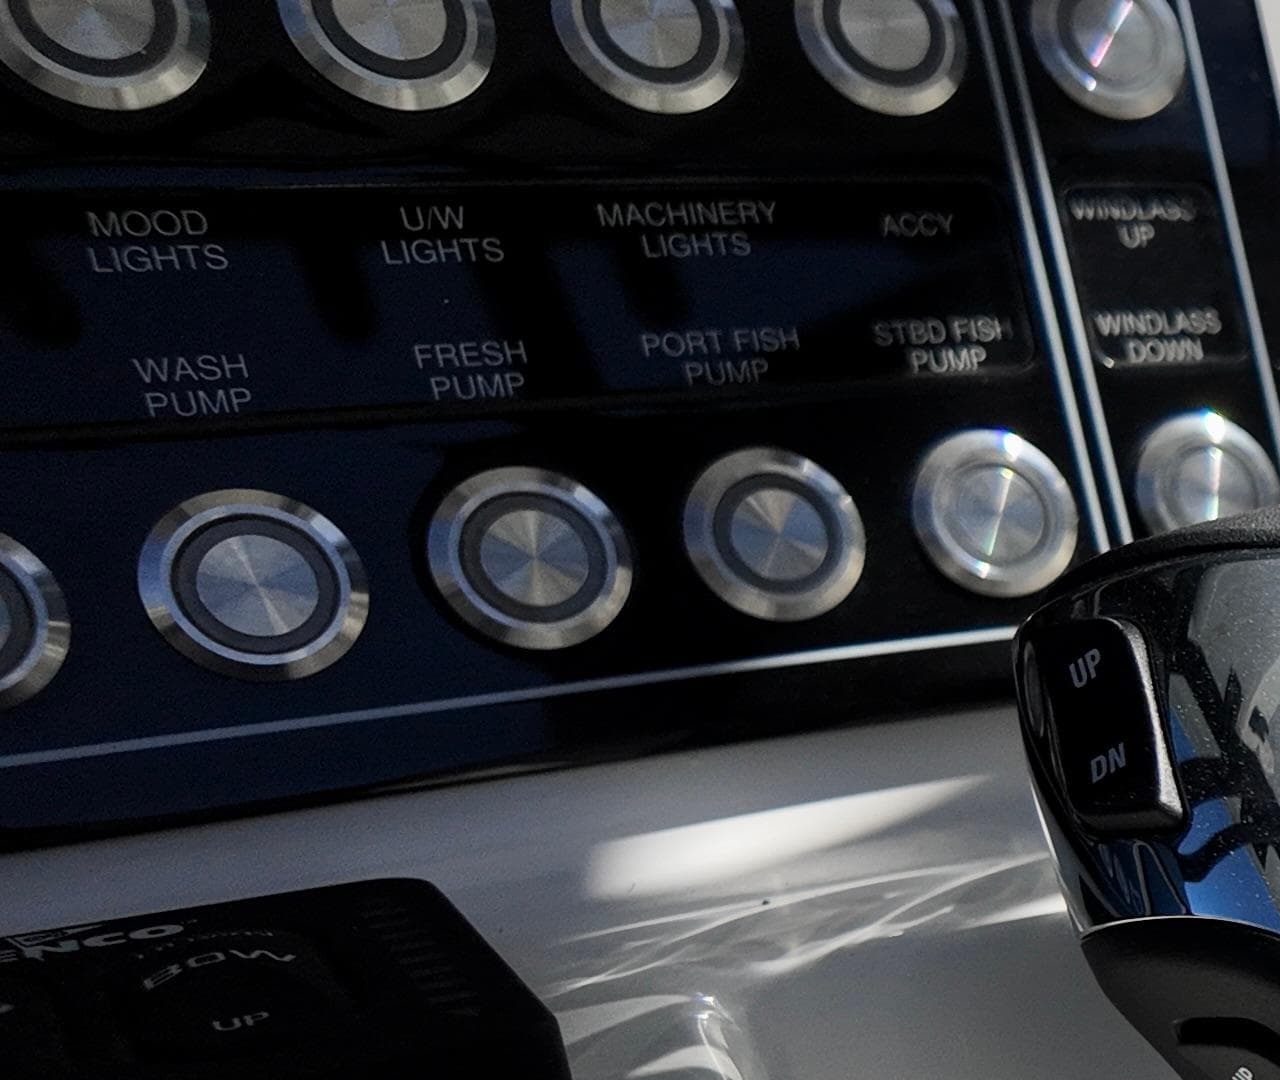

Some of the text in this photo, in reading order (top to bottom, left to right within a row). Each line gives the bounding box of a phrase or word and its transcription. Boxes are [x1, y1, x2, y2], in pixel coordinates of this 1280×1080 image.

[399, 205, 465, 232] U/W
[594, 200, 776, 228] MACHINERY
[1069, 195, 1197, 222] WINDLASS
[84, 209, 208, 238] MOOD
[881, 212, 954, 238] ACCY
[1117, 222, 1155, 248] UP
[88, 243, 229, 273] LIGHTS
[379, 237, 504, 266] LIGHTS
[640, 231, 752, 259] LIGHTS
[870, 316, 1012, 347] STBD FISH
[1094, 306, 1222, 336] WINDLASS
[414, 339, 528, 370] FRESH
[641, 326, 800, 358] PORT FISH
[1124, 335, 1203, 362] DOWN
[132, 354, 249, 384] WASH
[683, 359, 769, 386] PUMP
[907, 345, 987, 374] PUMP
[429, 373, 525, 401] PUMP
[144, 388, 252, 418] PUMP
[1068, 648, 1103, 689] UP
[1090, 742, 1127, 784] DN
[143, 949, 296, 991] BOW
[212, 1011, 270, 1031] UP
